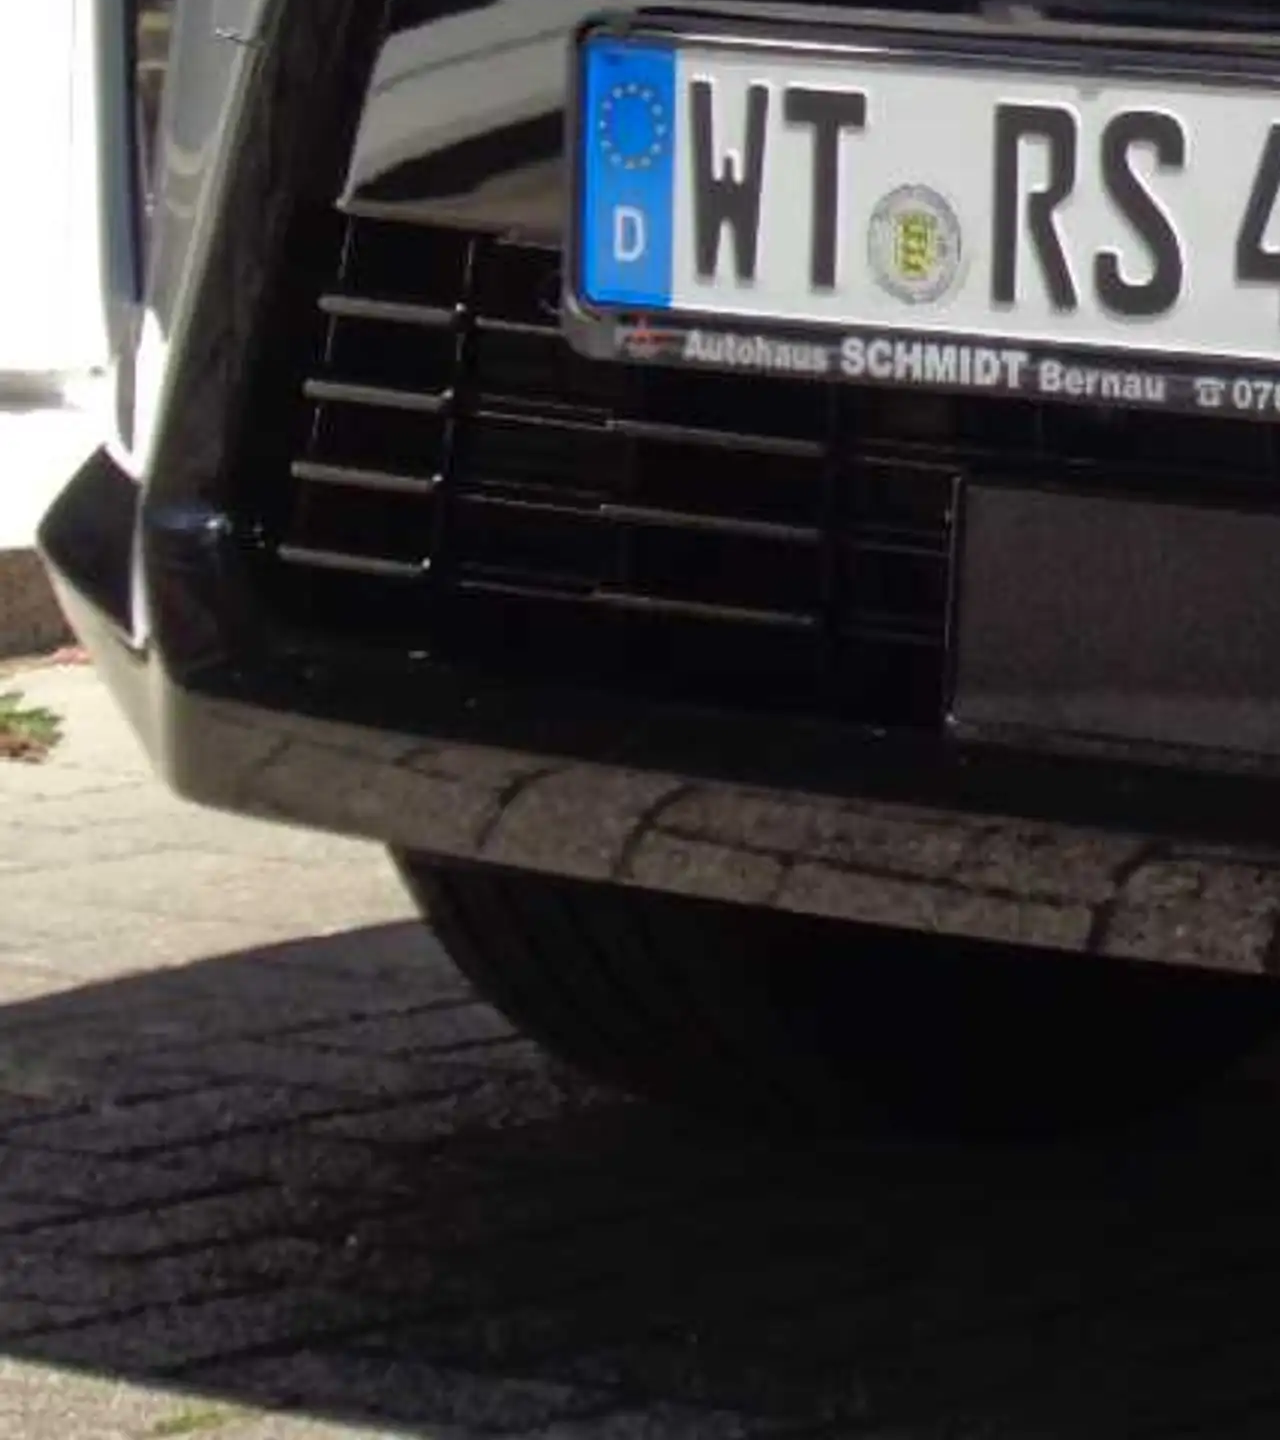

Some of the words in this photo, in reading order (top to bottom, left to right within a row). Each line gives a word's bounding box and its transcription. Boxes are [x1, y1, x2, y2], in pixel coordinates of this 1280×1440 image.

[612, 206, 647, 262] D
[688, 79, 868, 291] WT
[990, 102, 1187, 317] RS
[681, 329, 828, 372] Autohaus
[840, 337, 1029, 389] SCHMIDT
[1038, 360, 1166, 402] Bernau
